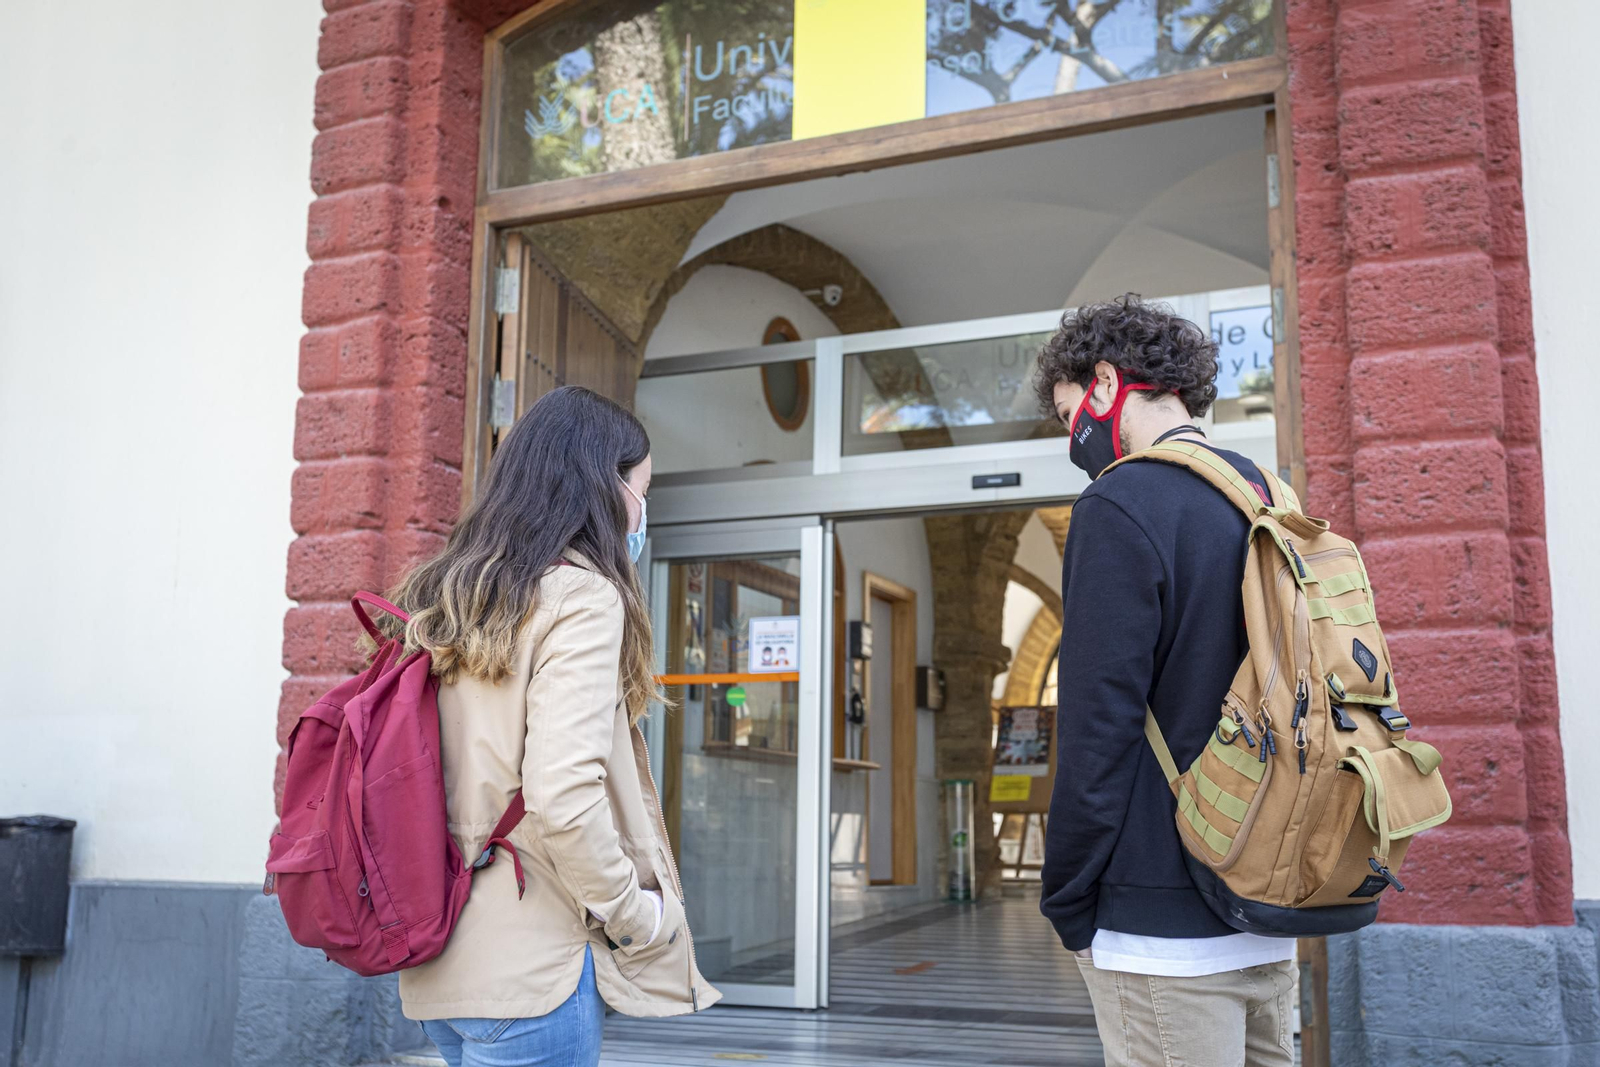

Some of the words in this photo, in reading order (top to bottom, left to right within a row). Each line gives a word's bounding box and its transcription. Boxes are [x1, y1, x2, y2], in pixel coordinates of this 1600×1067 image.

[579, 83, 659, 129] UCA
[1231, 356, 1245, 378] y
[1078, 425, 1093, 445] BIKES
